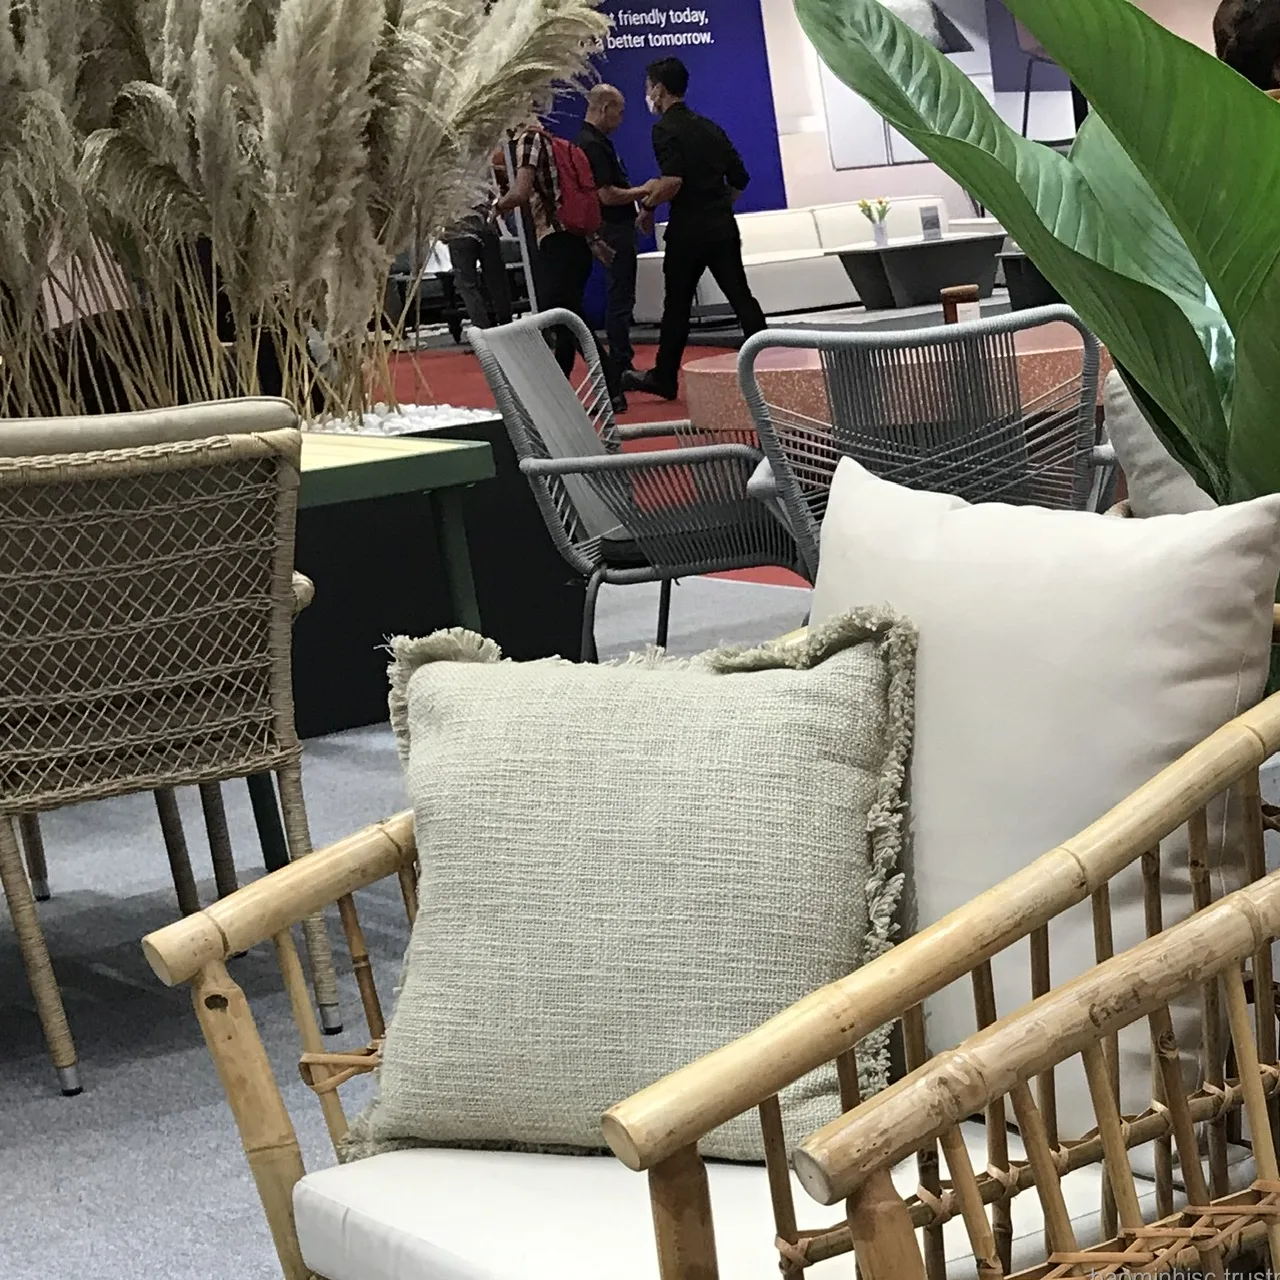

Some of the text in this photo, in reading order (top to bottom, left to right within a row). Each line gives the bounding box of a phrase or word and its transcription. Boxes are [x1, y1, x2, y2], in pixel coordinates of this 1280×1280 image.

[618, 8, 667, 28] friendly
[669, 6, 709, 26] today,
[607, 33, 646, 49] better
[648, 31, 715, 47] tomorrow.
